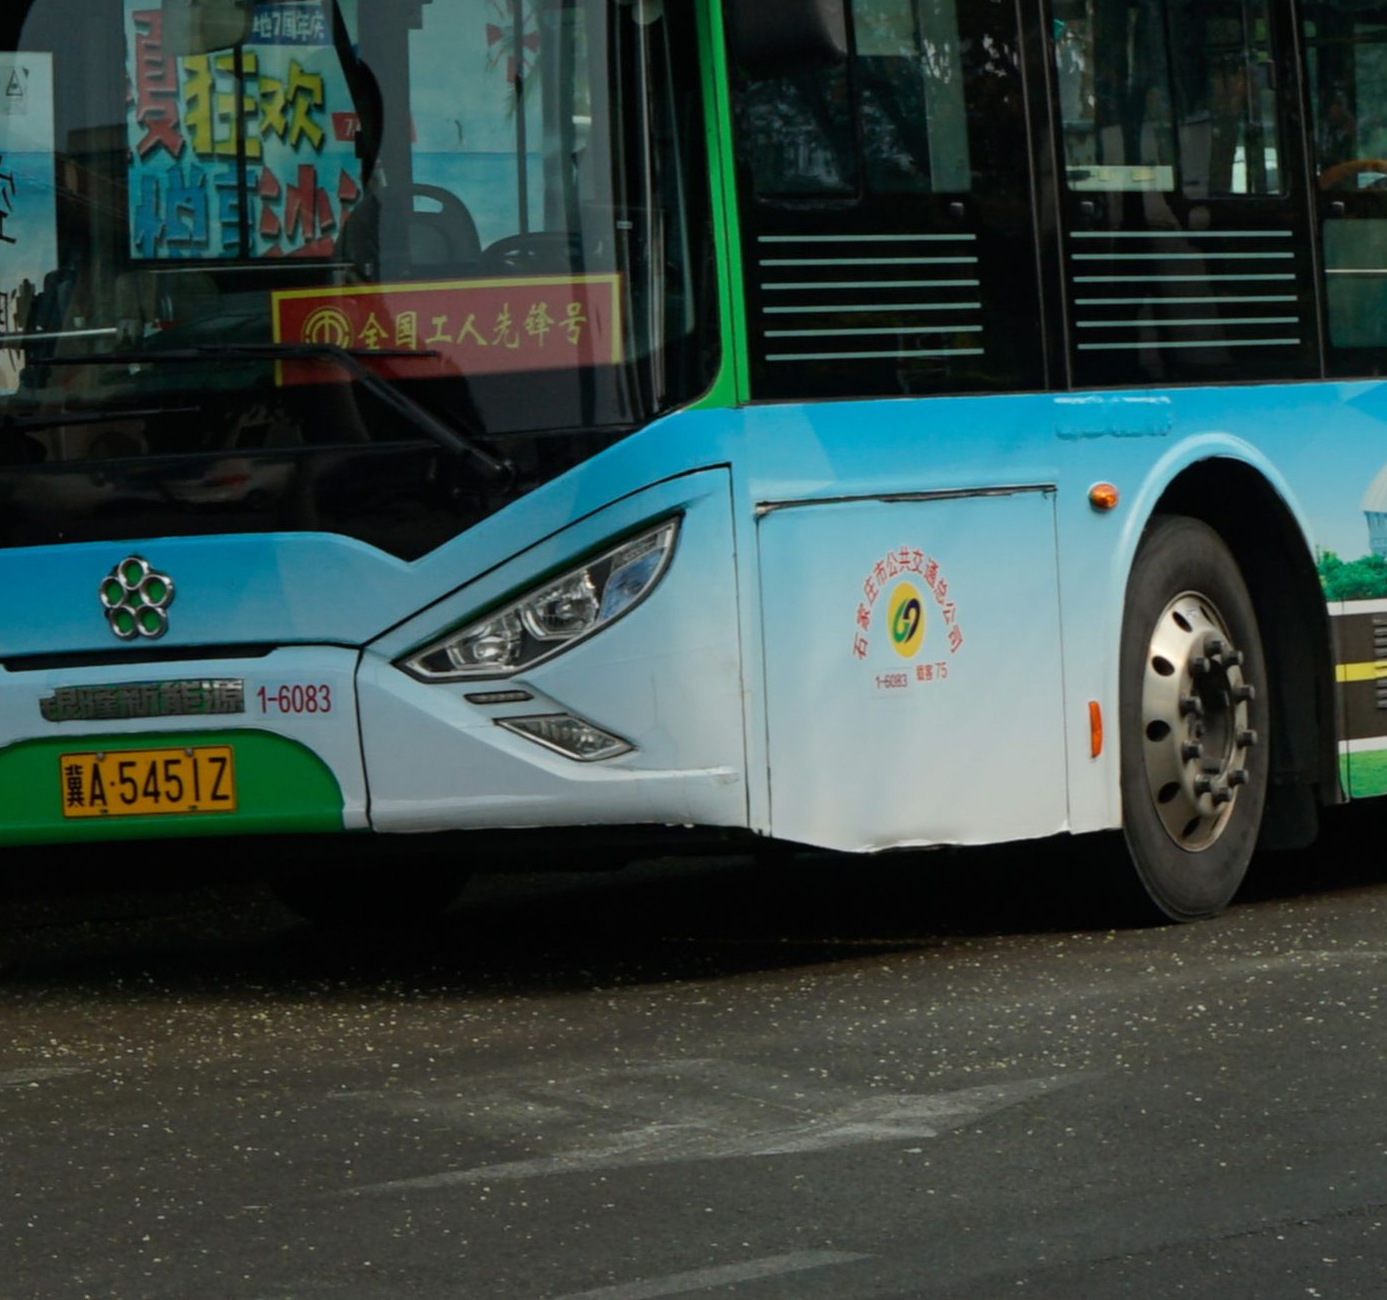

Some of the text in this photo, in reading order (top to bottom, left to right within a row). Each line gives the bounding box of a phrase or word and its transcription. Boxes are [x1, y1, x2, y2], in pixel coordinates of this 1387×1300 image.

[357, 302, 589, 351] 全国工人先锋号
[875, 674, 909, 689] 1-6083
[256, 684, 332, 715] 1-6083
